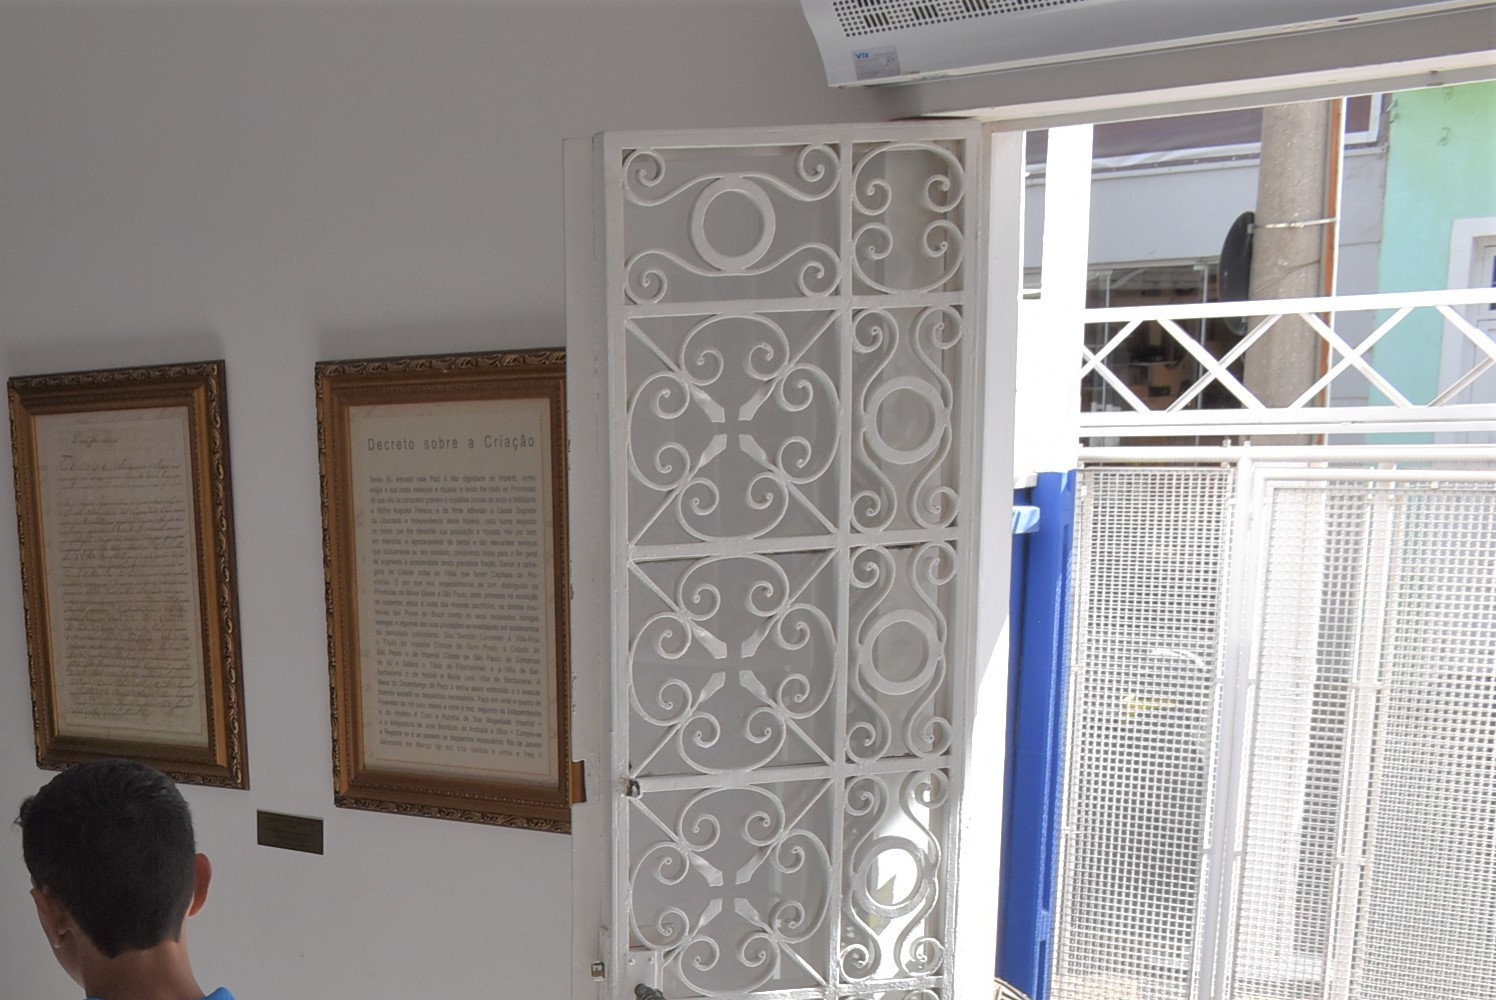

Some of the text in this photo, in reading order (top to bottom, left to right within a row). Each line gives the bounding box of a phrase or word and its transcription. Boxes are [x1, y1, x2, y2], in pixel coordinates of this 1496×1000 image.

[367, 433, 535, 451] Decreto sobre a Criação
